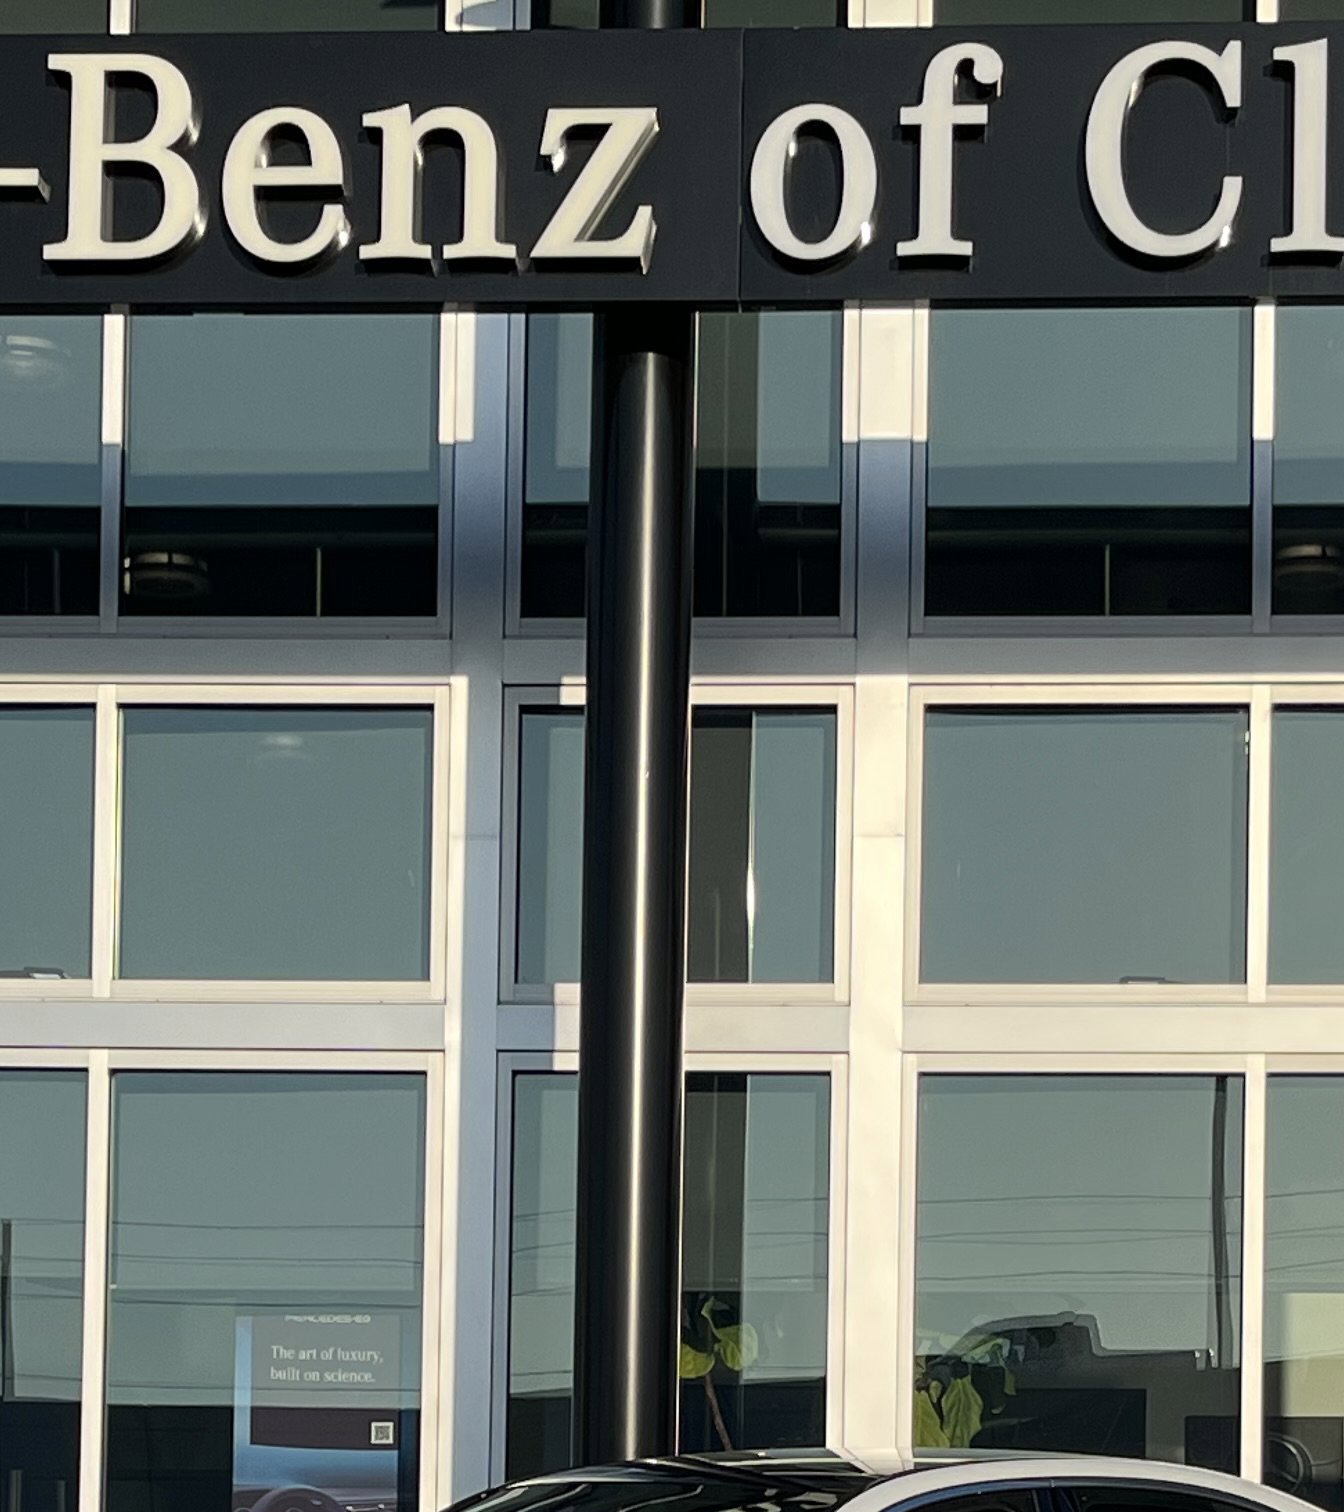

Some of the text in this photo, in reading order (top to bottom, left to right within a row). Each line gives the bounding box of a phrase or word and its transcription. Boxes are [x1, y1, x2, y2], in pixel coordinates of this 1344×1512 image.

[749, 42, 1004, 261] of
[271, 1345, 384, 1364] The art of luxury,
[270, 1365, 376, 1383] built on science.
